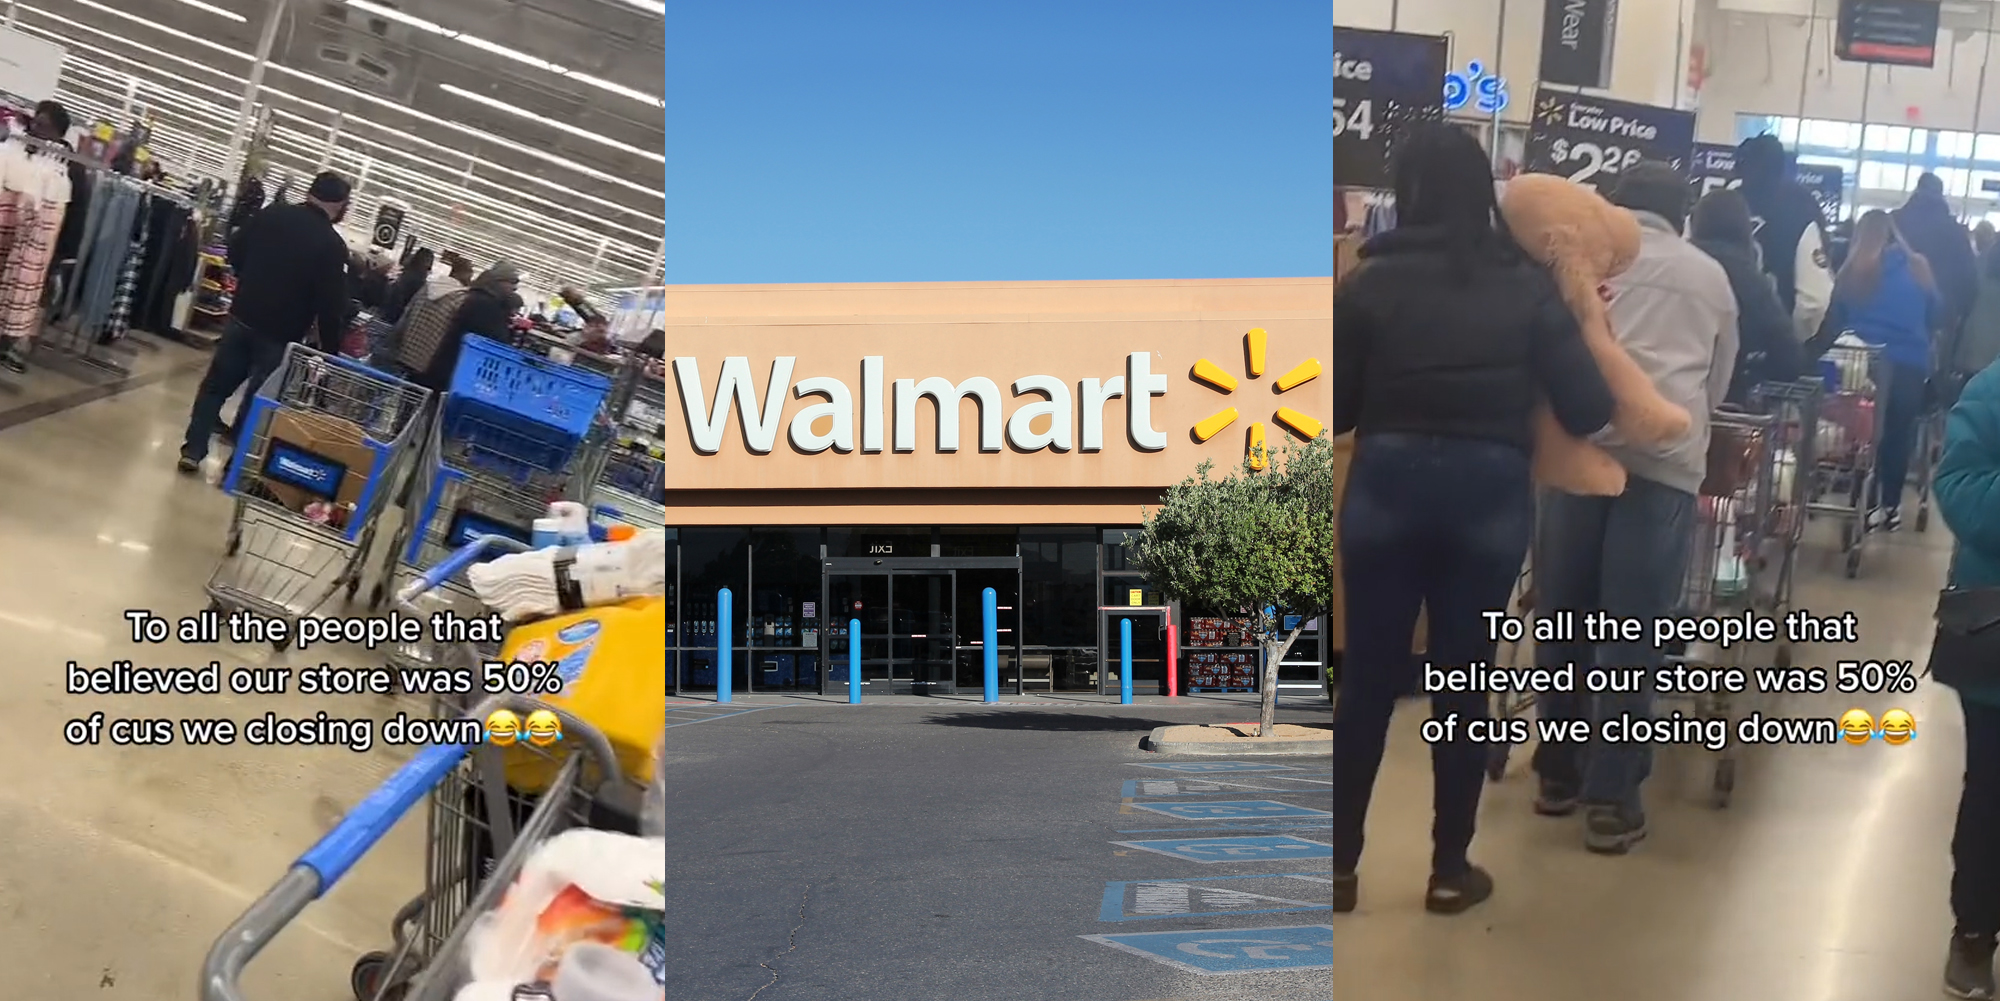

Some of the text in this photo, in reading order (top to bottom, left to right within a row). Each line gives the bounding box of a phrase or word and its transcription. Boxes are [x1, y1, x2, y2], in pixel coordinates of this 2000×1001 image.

[1562, 0, 1587, 50] Wear
[1567, 110, 1658, 141] Low Price
[674, 351, 1168, 454] Walmart
